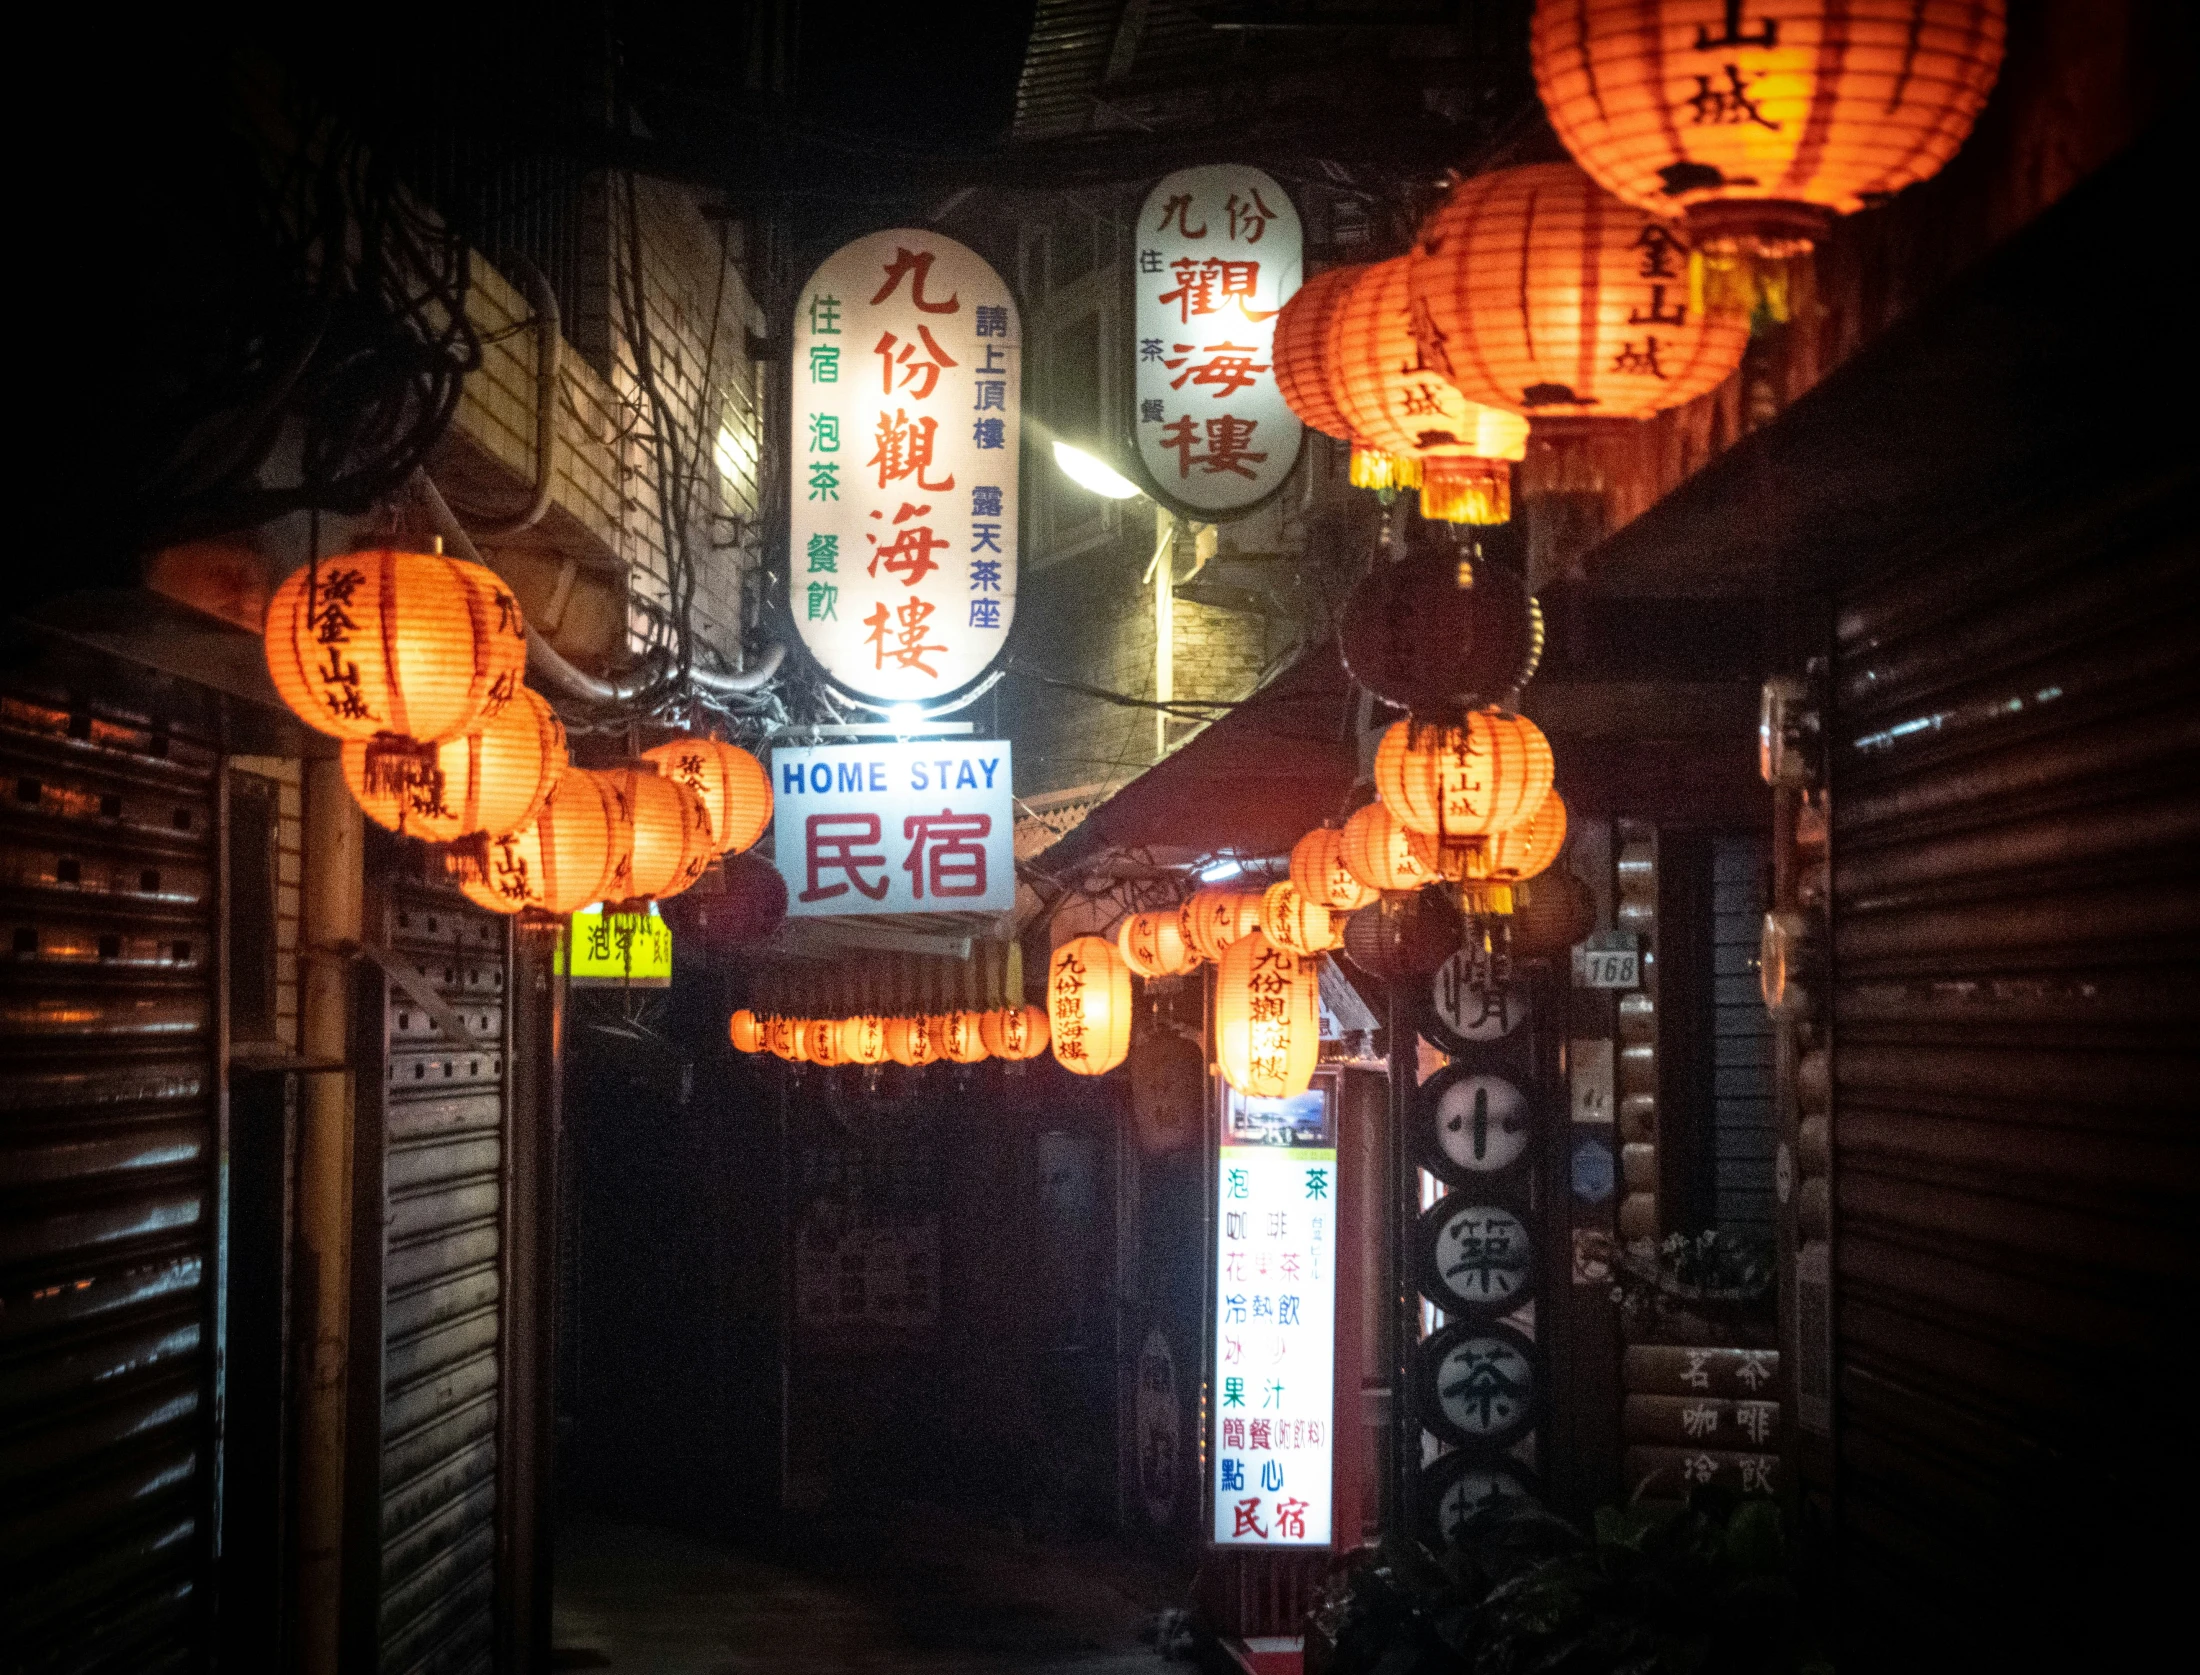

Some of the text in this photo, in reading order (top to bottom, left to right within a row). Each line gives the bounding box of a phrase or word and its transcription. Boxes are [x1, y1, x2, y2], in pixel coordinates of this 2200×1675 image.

[1157, 188, 1278, 244] 九份
[808, 295, 841, 384] 住宿
[1611, 222, 1686, 381] 金山城
[973, 306, 1007, 450] 請上頂樓
[1158, 256, 1280, 480] 觀海樓
[808, 412, 840, 502] 泡茶
[863, 247, 960, 679] 九份觀海樓
[806, 534, 839, 623] 餐飲
[969, 485, 1004, 629] 露天茶座
[783, 758, 999, 794] HOME STAY
[798, 808, 992, 902] 民宿
[1055, 953, 1089, 1061] 九份觀海樓
[1591, 956, 1634, 982] 168
[1226, 1210, 1288, 1241] 咖啡
[1225, 1293, 1300, 1326] 冷熱飲
[1223, 1377, 1285, 1409] 果汁
[1683, 1404, 1770, 1444] 咖啡
[1221, 1458, 1284, 1492] 點心
[1232, 1497, 1310, 1540] 民宿
